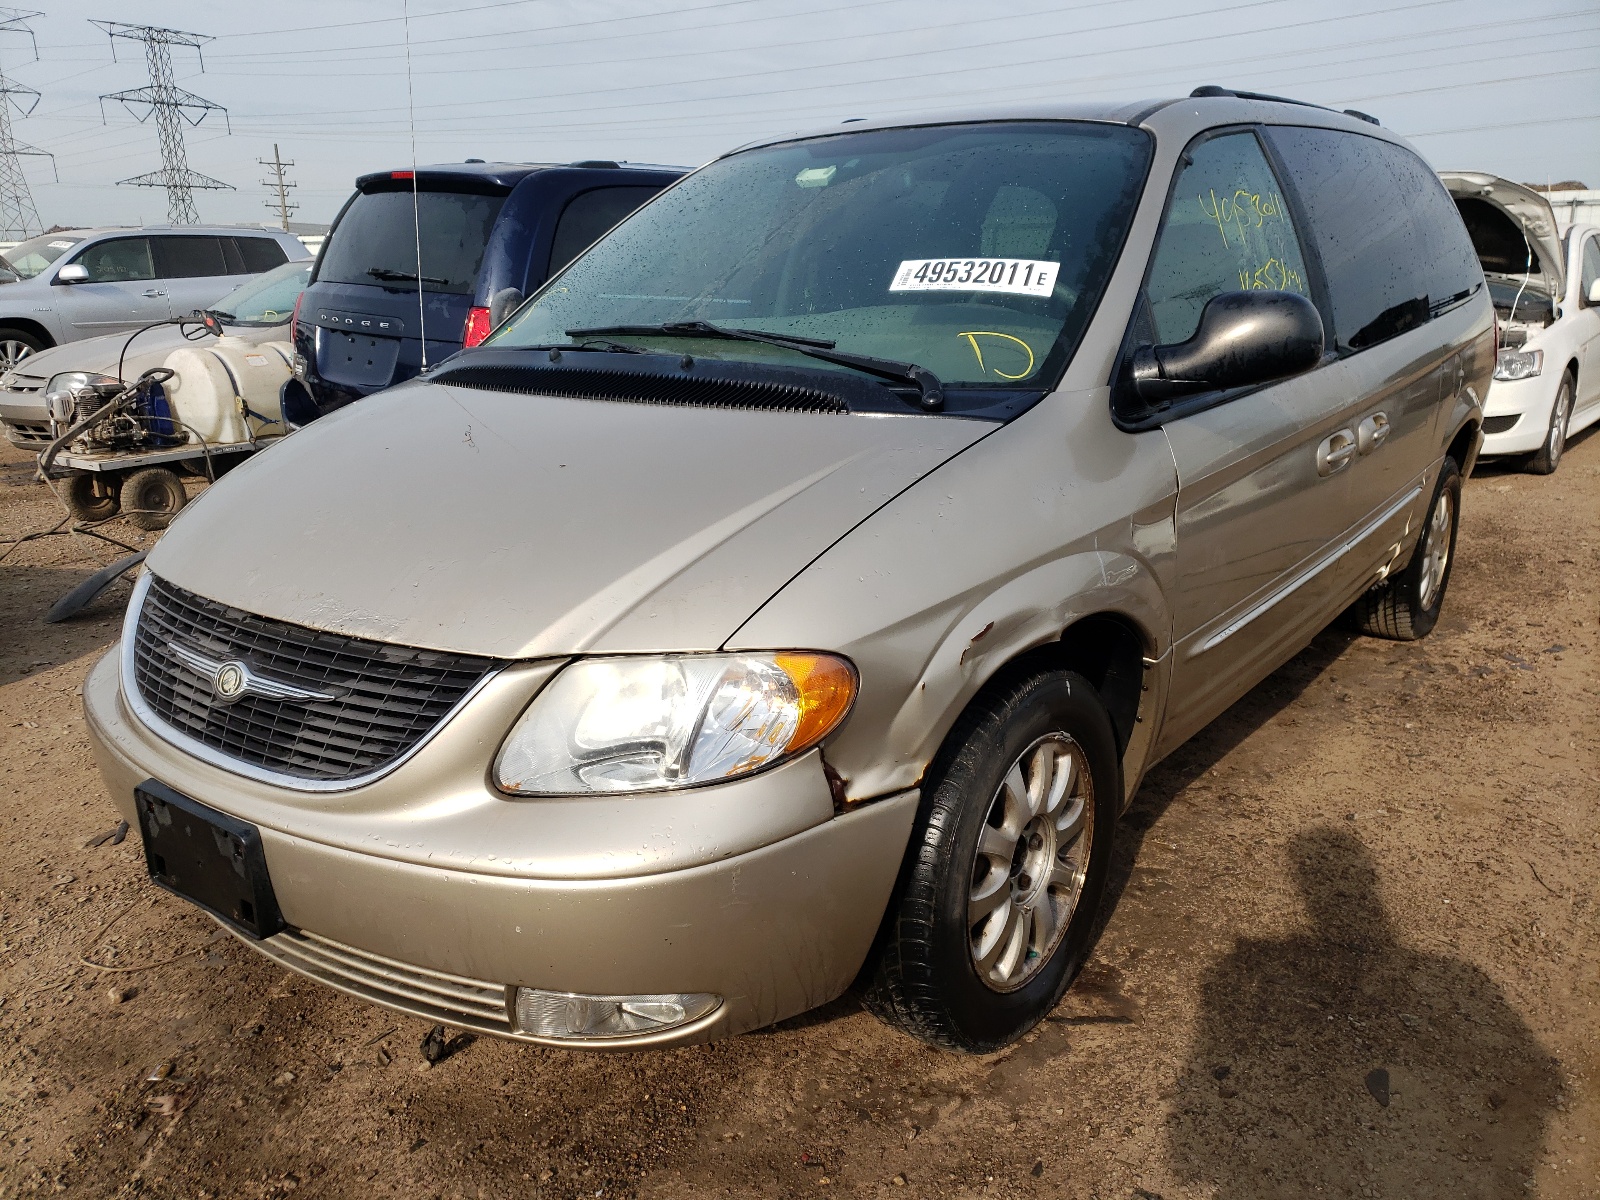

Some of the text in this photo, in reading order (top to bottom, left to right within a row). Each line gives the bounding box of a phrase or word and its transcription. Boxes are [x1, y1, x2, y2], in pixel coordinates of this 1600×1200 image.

[913, 260, 1035, 287] 49532011
[1036, 272, 1048, 286] E
[320, 314, 390, 329] DODGE
[957, 331, 1035, 379] D
